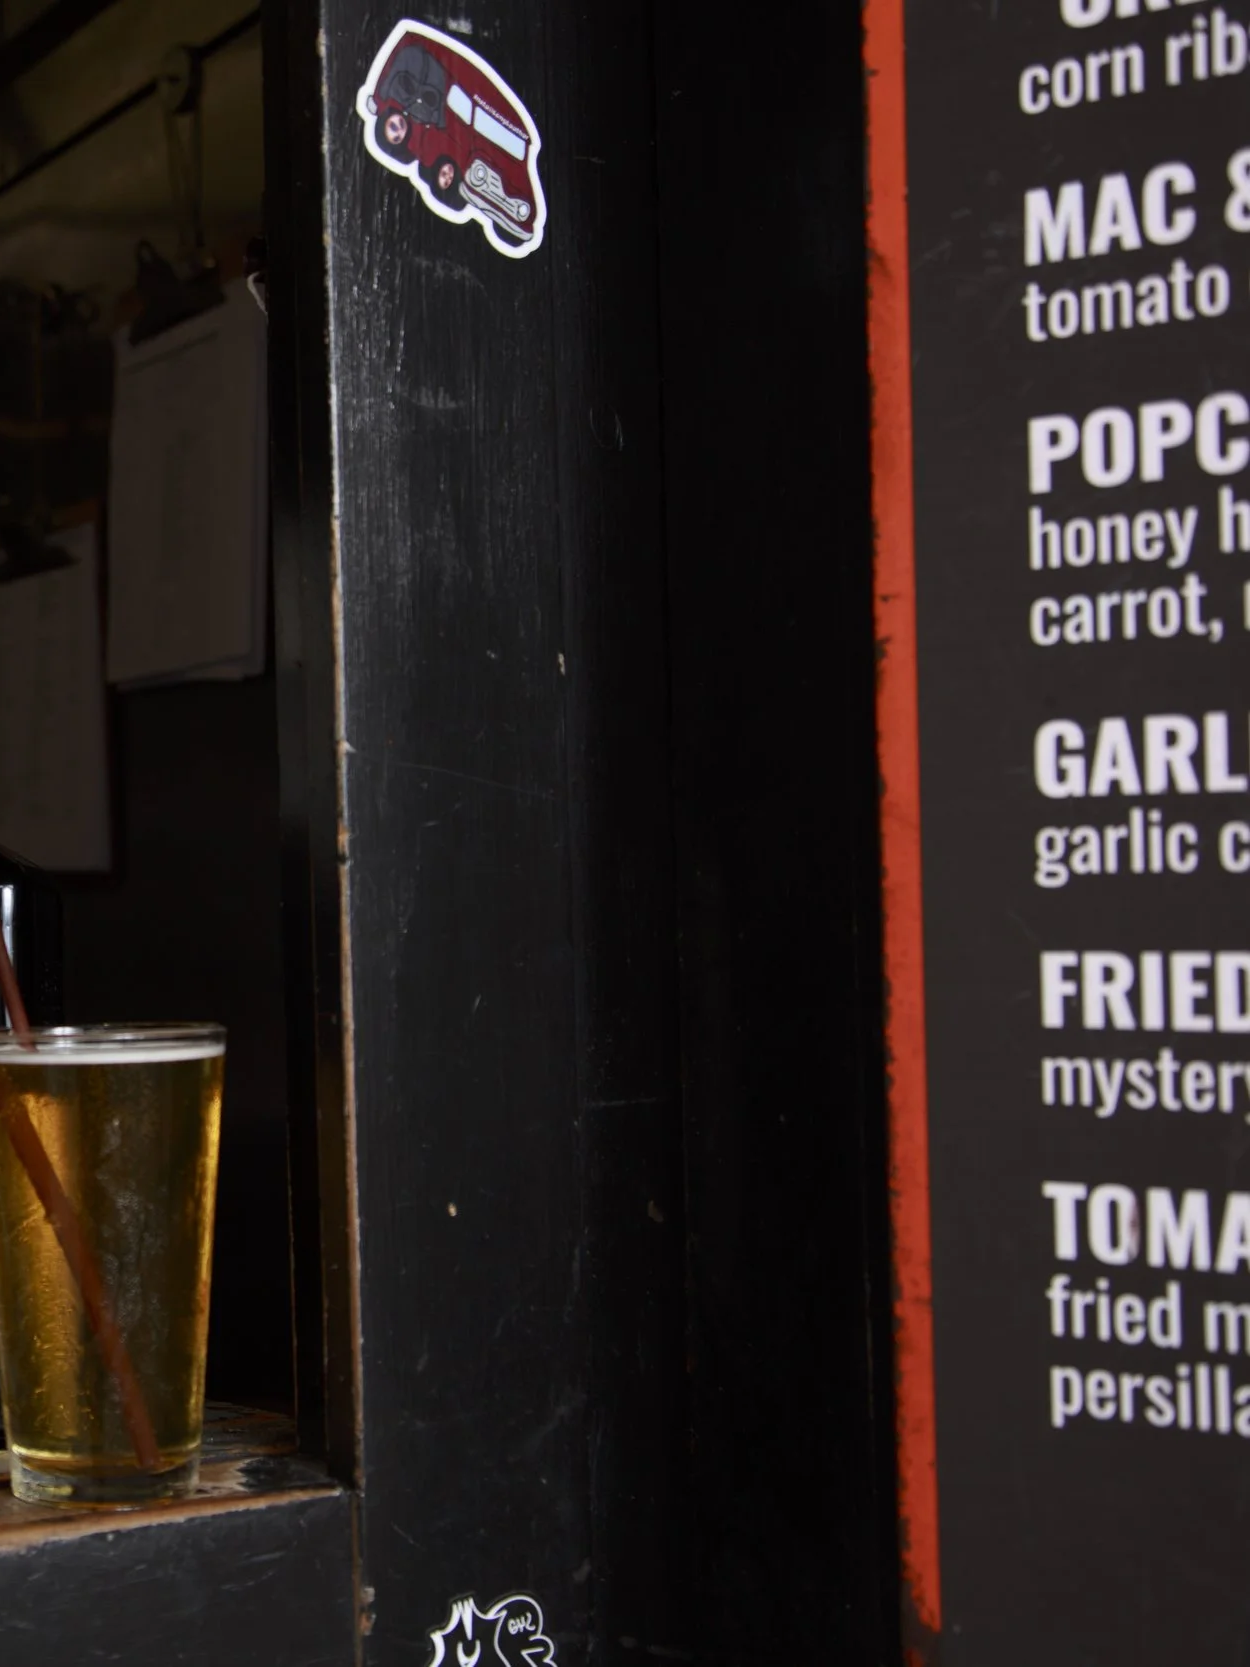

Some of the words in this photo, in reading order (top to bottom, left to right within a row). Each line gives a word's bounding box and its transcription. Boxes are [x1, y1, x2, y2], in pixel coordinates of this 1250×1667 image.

[1018, 44, 1144, 115] corn
[1166, 8, 1250, 85] rib
[1025, 162, 1196, 267] MAC
[1023, 258, 1230, 342] tomato
[1029, 391, 1250, 494] POPC
[1029, 506, 1198, 571] honey
[1031, 573, 1224, 646] carrot,
[1035, 711, 1250, 799] GARL
[1035, 807, 1199, 888] garlic
[1041, 950, 1250, 1033] FRIED
[1042, 1047, 1250, 1120] myster
[1042, 1181, 1250, 1274] TOMA
[1047, 1274, 1182, 1348] fried
